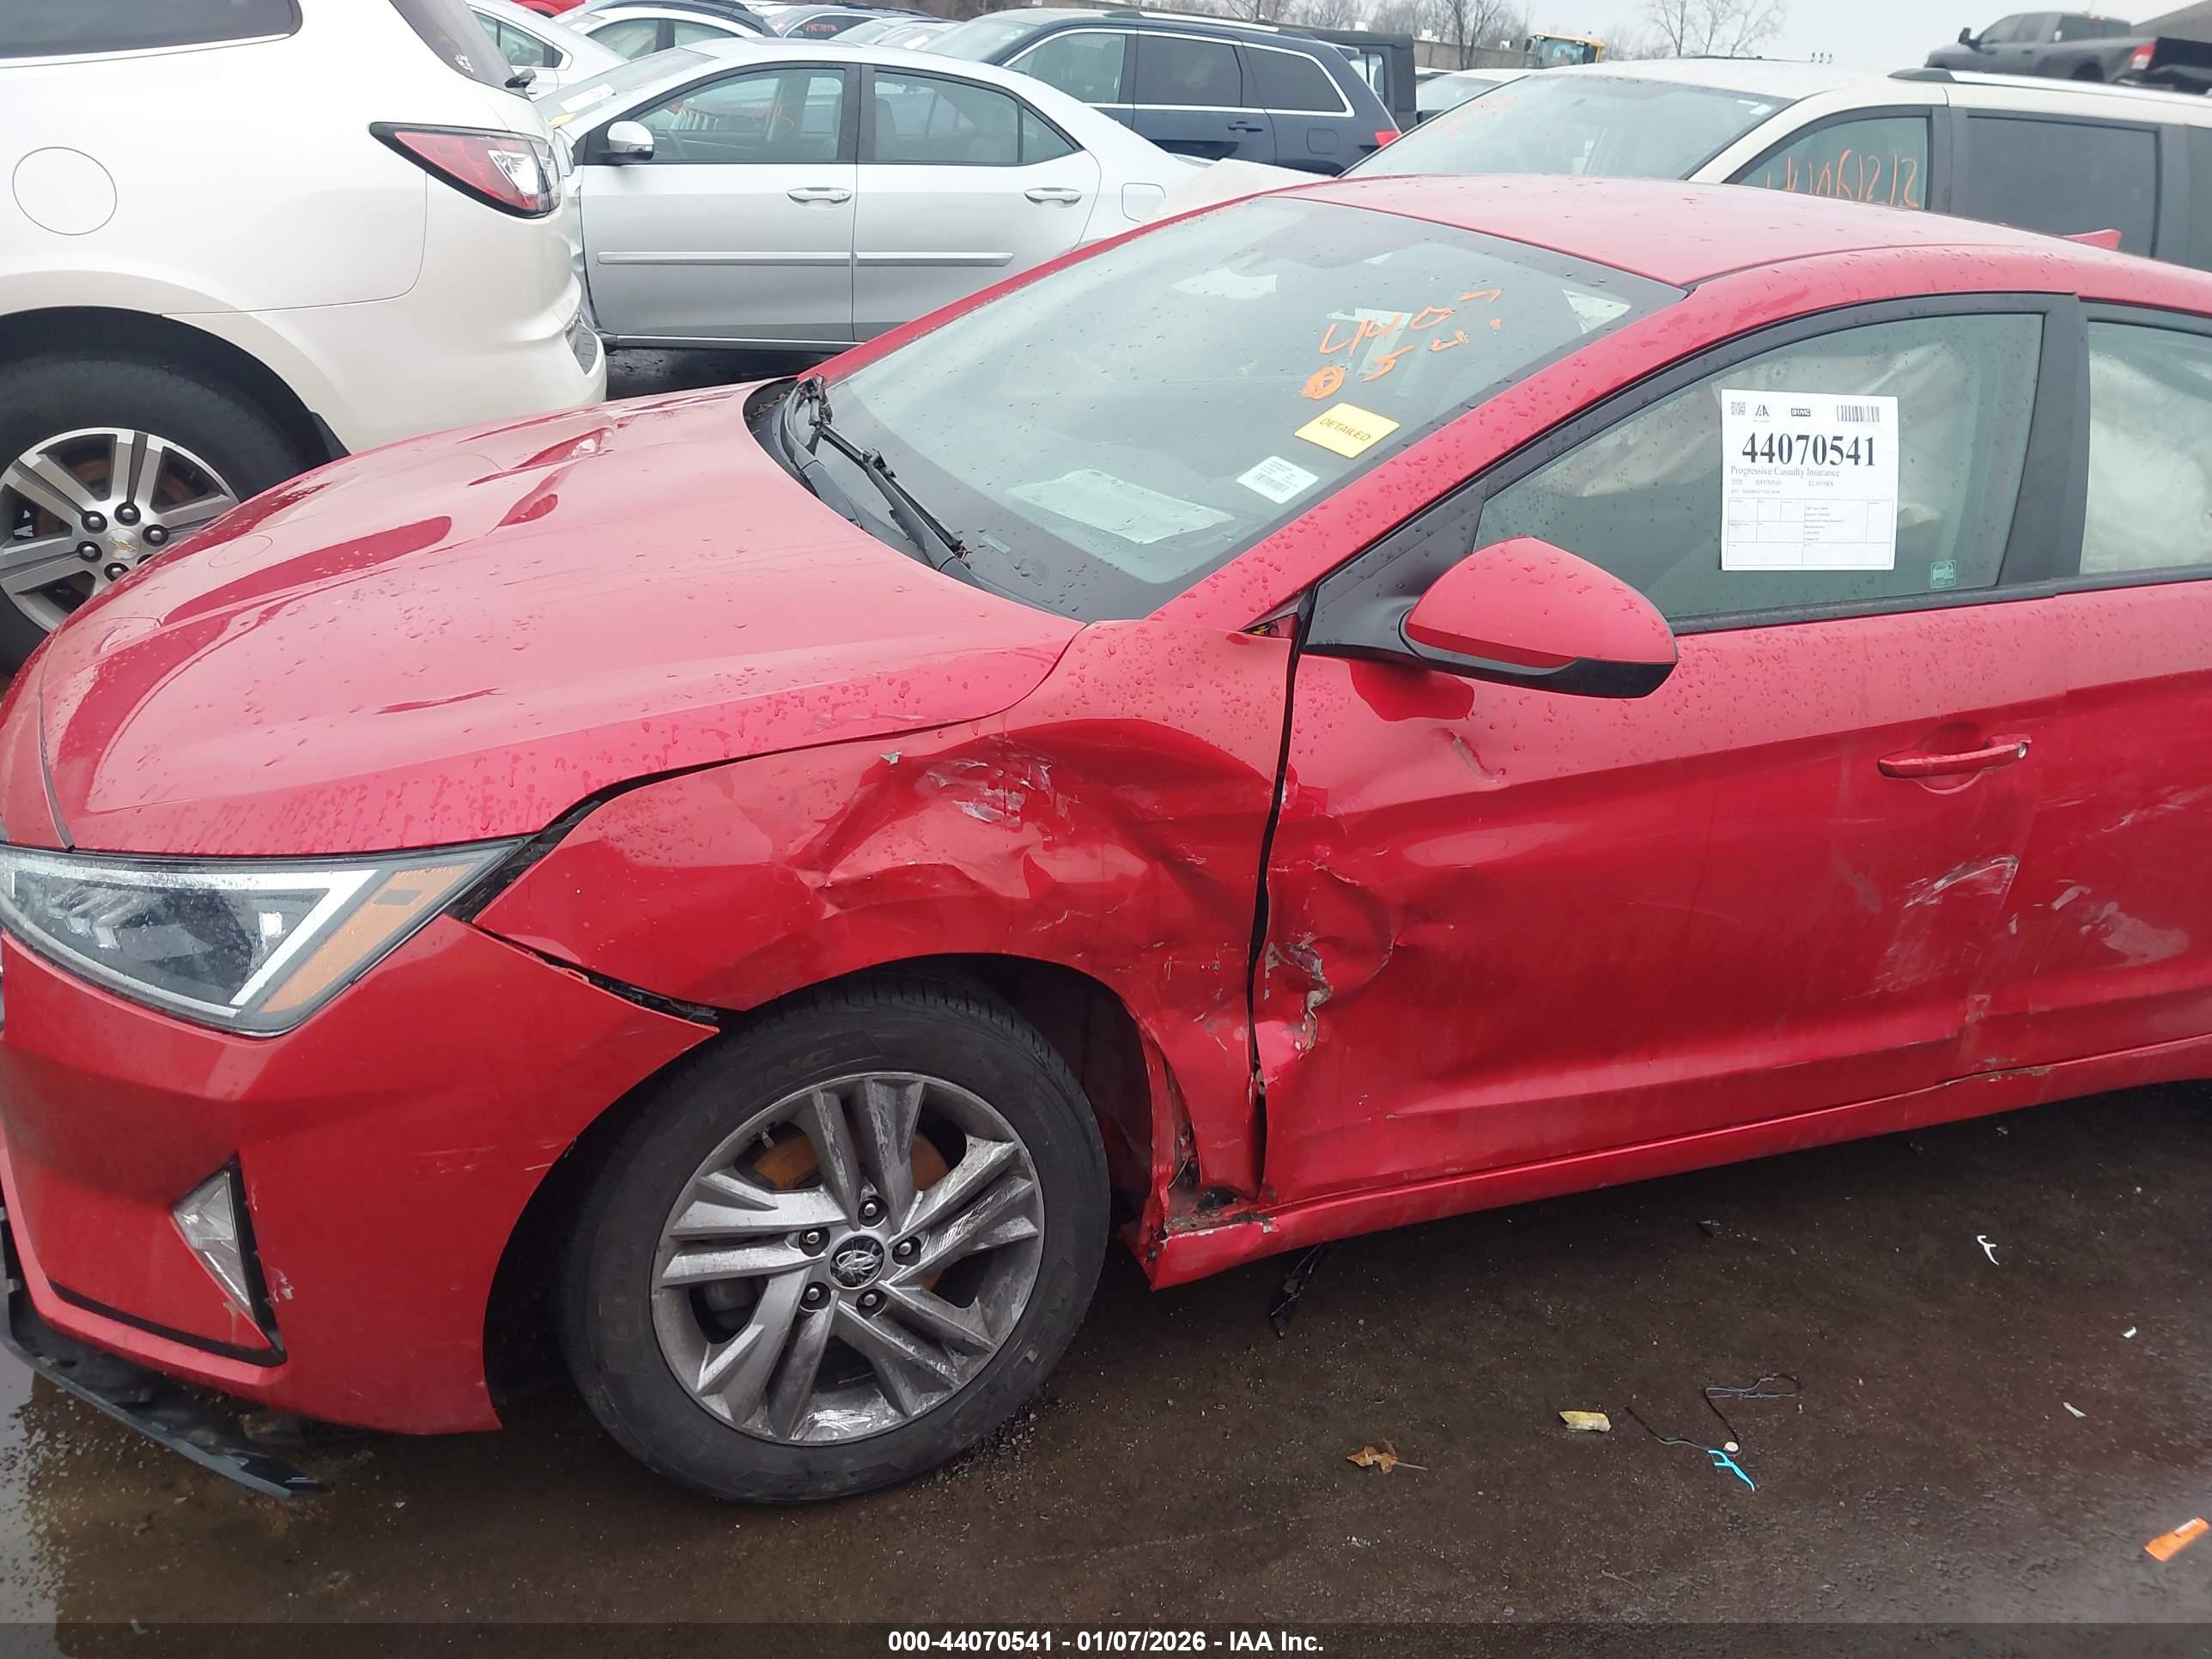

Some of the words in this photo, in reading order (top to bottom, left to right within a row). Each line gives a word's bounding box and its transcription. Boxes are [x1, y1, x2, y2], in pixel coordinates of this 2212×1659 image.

[1319, 417, 1372, 442] DETAILED
[1741, 432, 1876, 467] 44070541
[1730, 465, 1773, 477] Progressive
[1774, 466, 1805, 478] Casualty
[1807, 467, 1841, 477] Insurance
